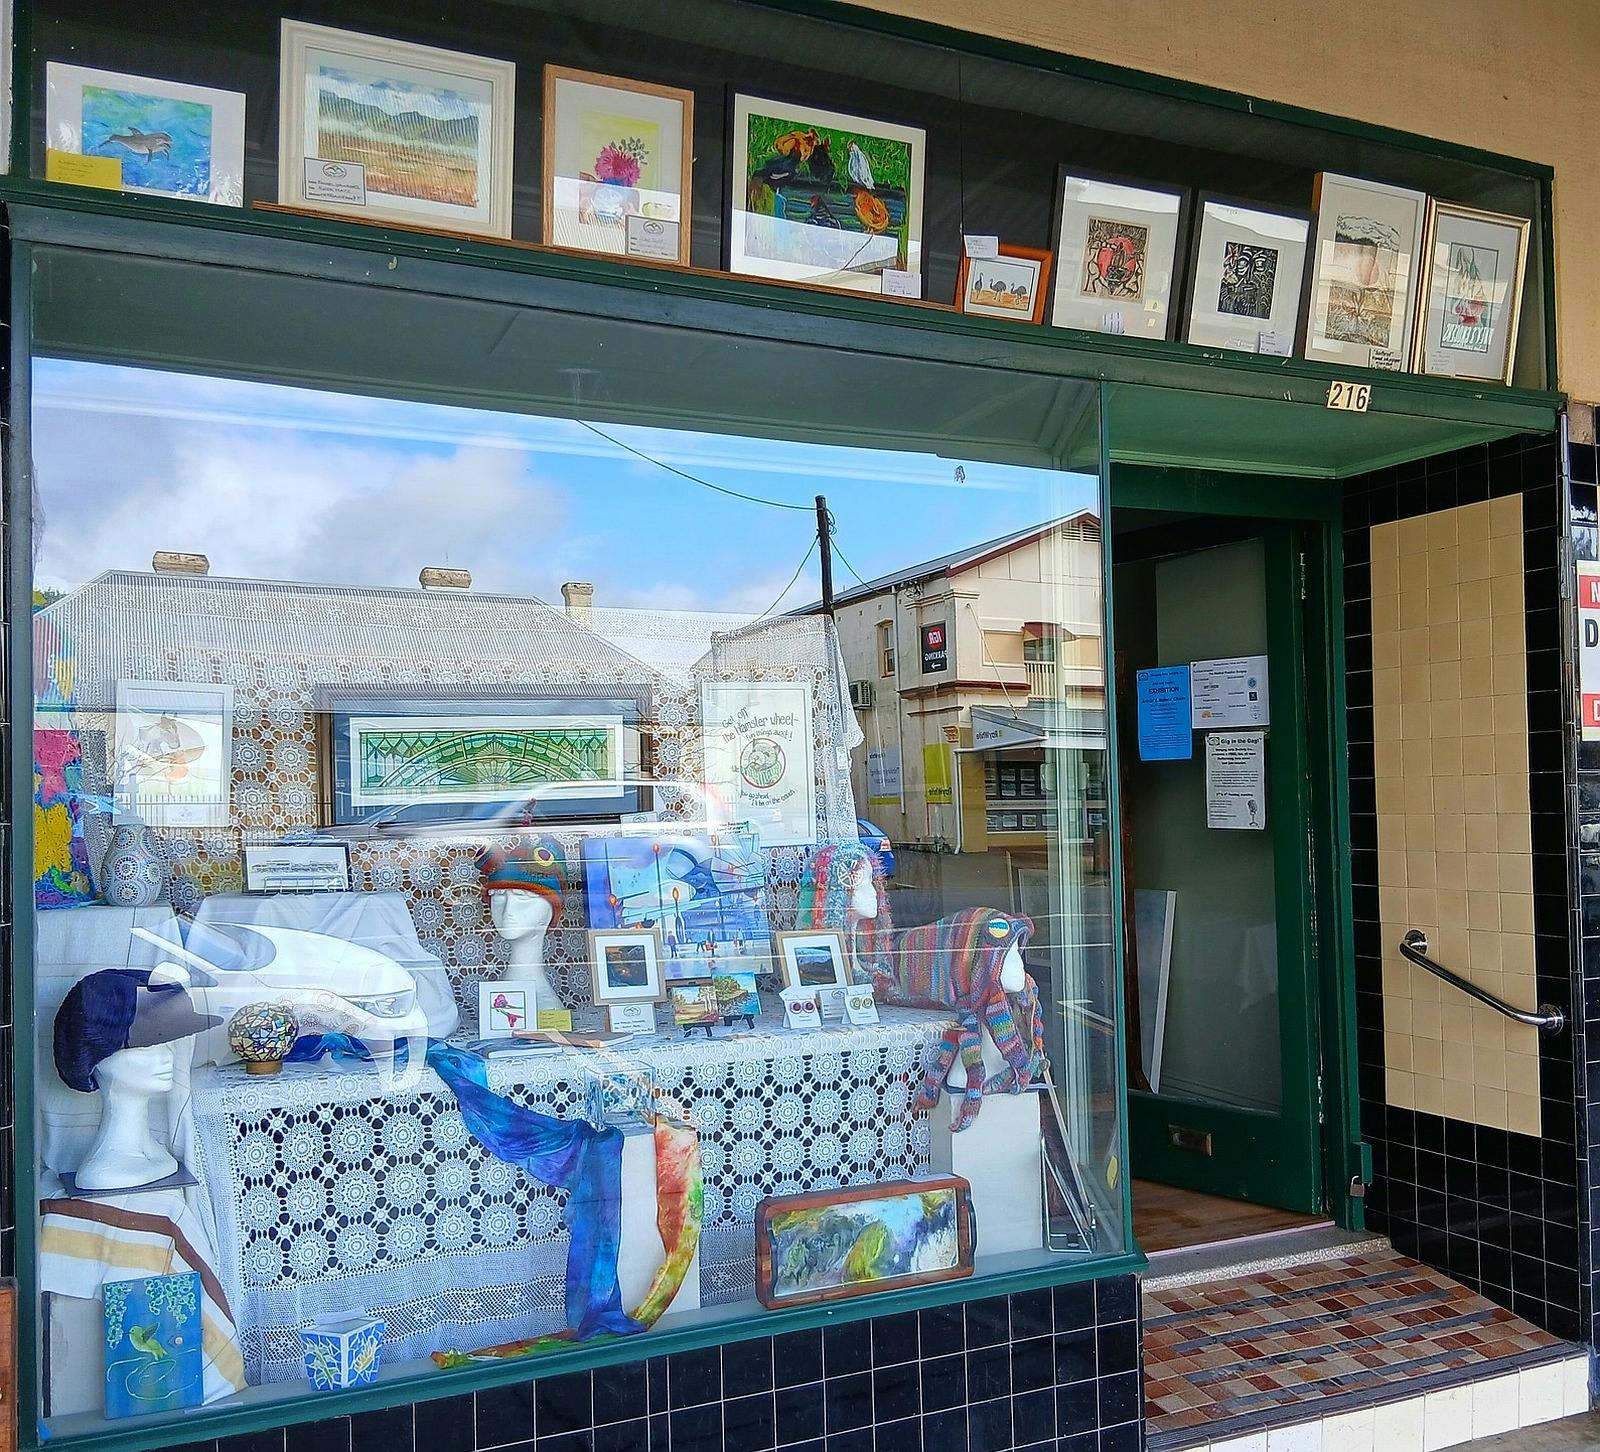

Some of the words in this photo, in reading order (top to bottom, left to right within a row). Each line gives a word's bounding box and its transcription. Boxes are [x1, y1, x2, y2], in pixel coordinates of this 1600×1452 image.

[1330, 383, 1368, 410] 216
[1148, 686, 1180, 695] EXHIBITION
[736, 706, 749, 720] off
[733, 716, 769, 735] hamster
